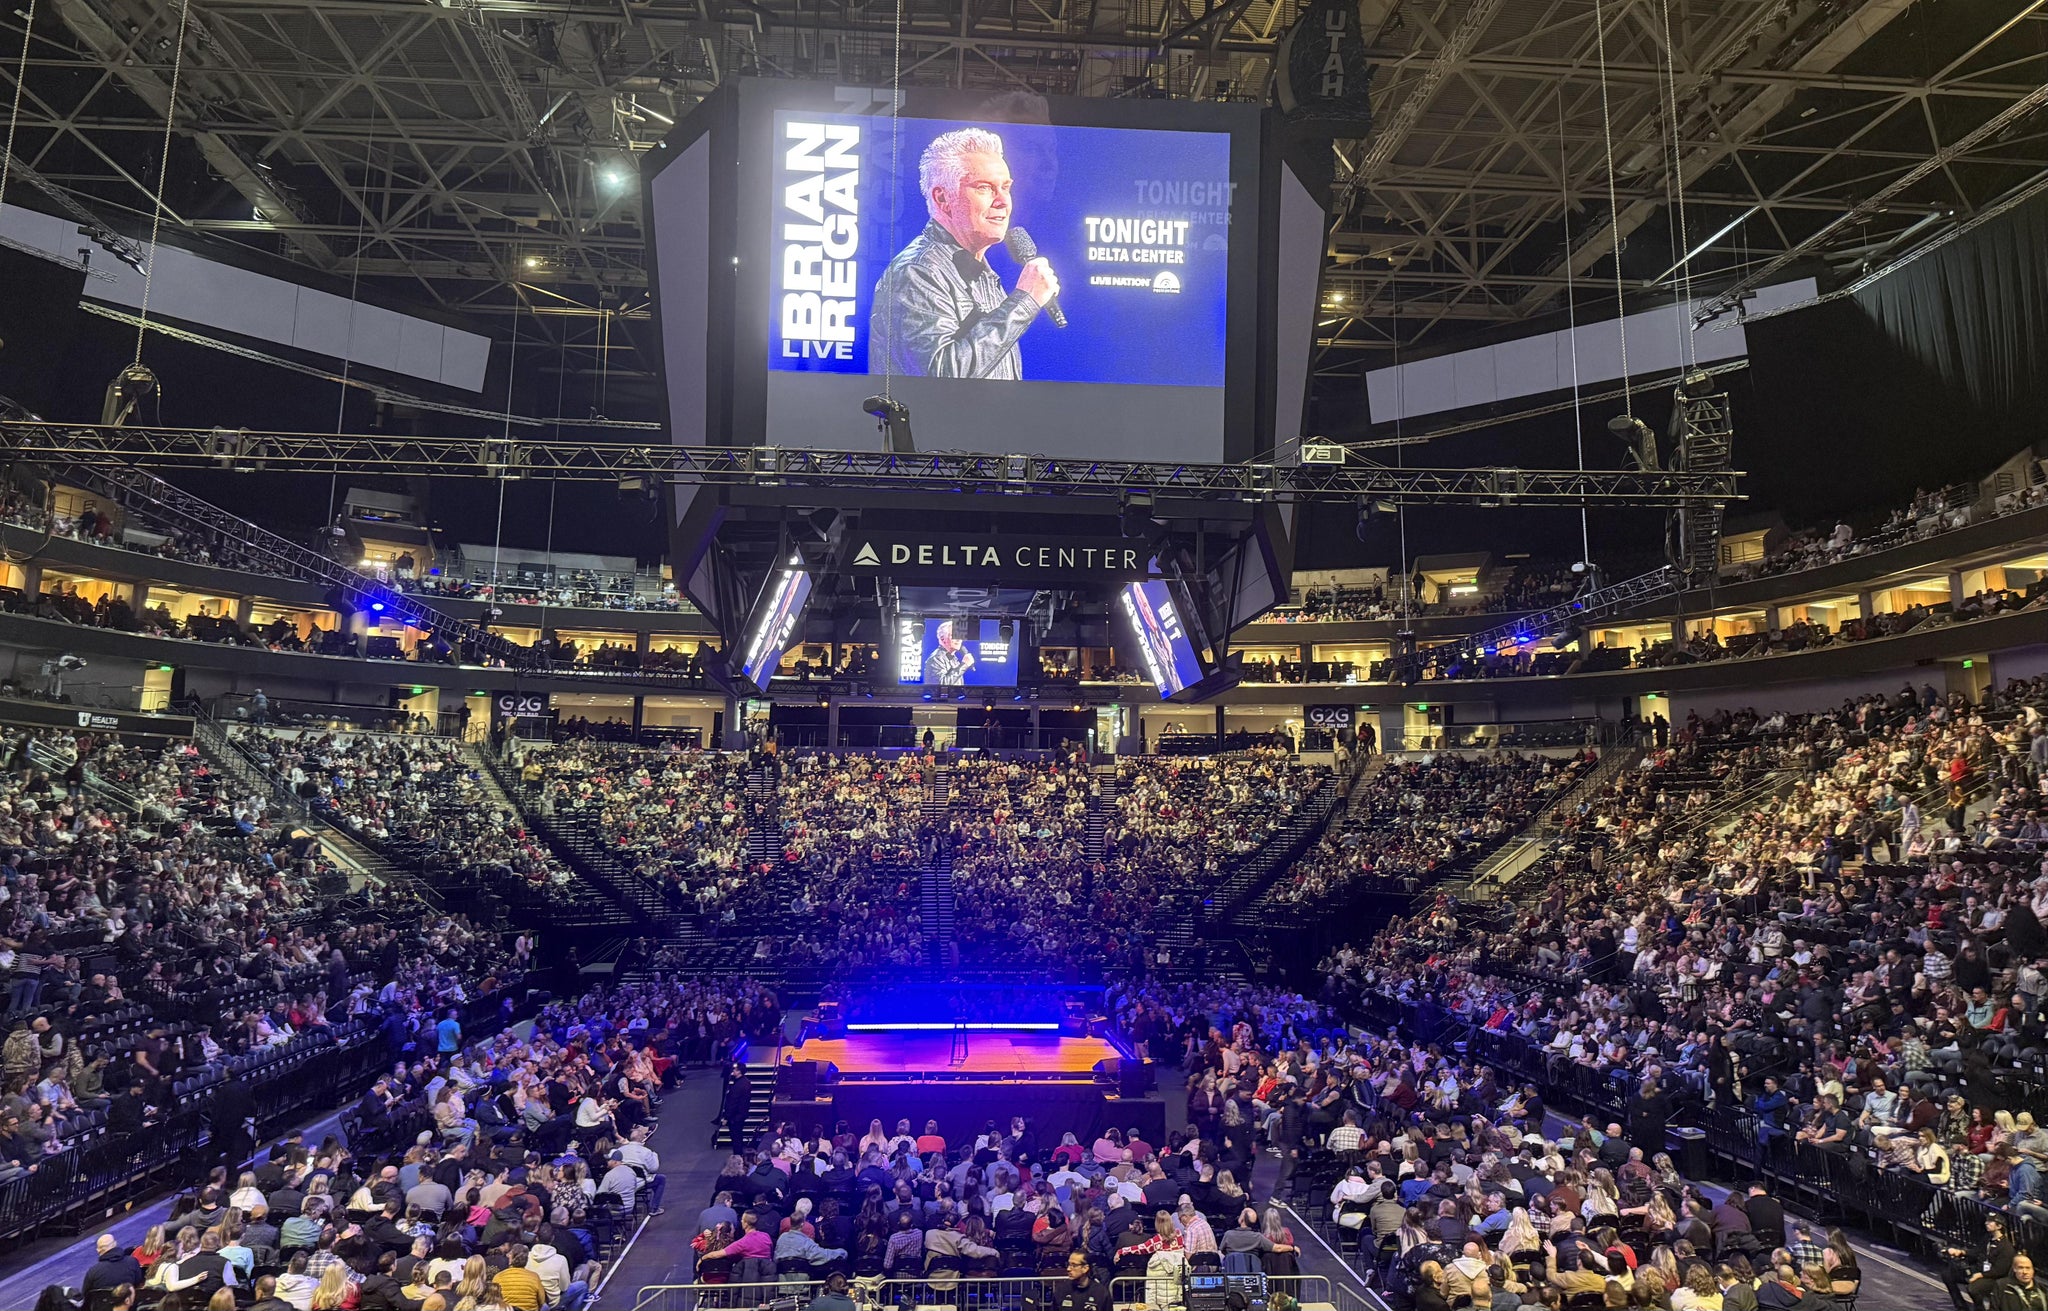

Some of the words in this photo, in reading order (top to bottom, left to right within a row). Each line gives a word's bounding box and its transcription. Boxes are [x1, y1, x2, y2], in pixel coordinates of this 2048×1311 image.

[1321, 9, 1347, 97] UTAH
[1134, 180, 1237, 206] TONIGHT
[782, 121, 825, 341] BRIAN
[820, 124, 860, 342] REGAN
[1085, 217, 1189, 245] TONIGHT
[1088, 247, 1130, 263] DELTA
[1132, 248, 1184, 264] CENTER
[1090, 276, 1112, 286] LIVE
[1112, 276, 1152, 287] NATION
[782, 339, 854, 360] LIVE
[891, 544, 1001, 566] DELTA
[1015, 547, 1137, 569] CENTER
[499, 695, 542, 712] G2G
[1310, 707, 1349, 722] G2G
[91, 715, 119, 725] HEALTH
